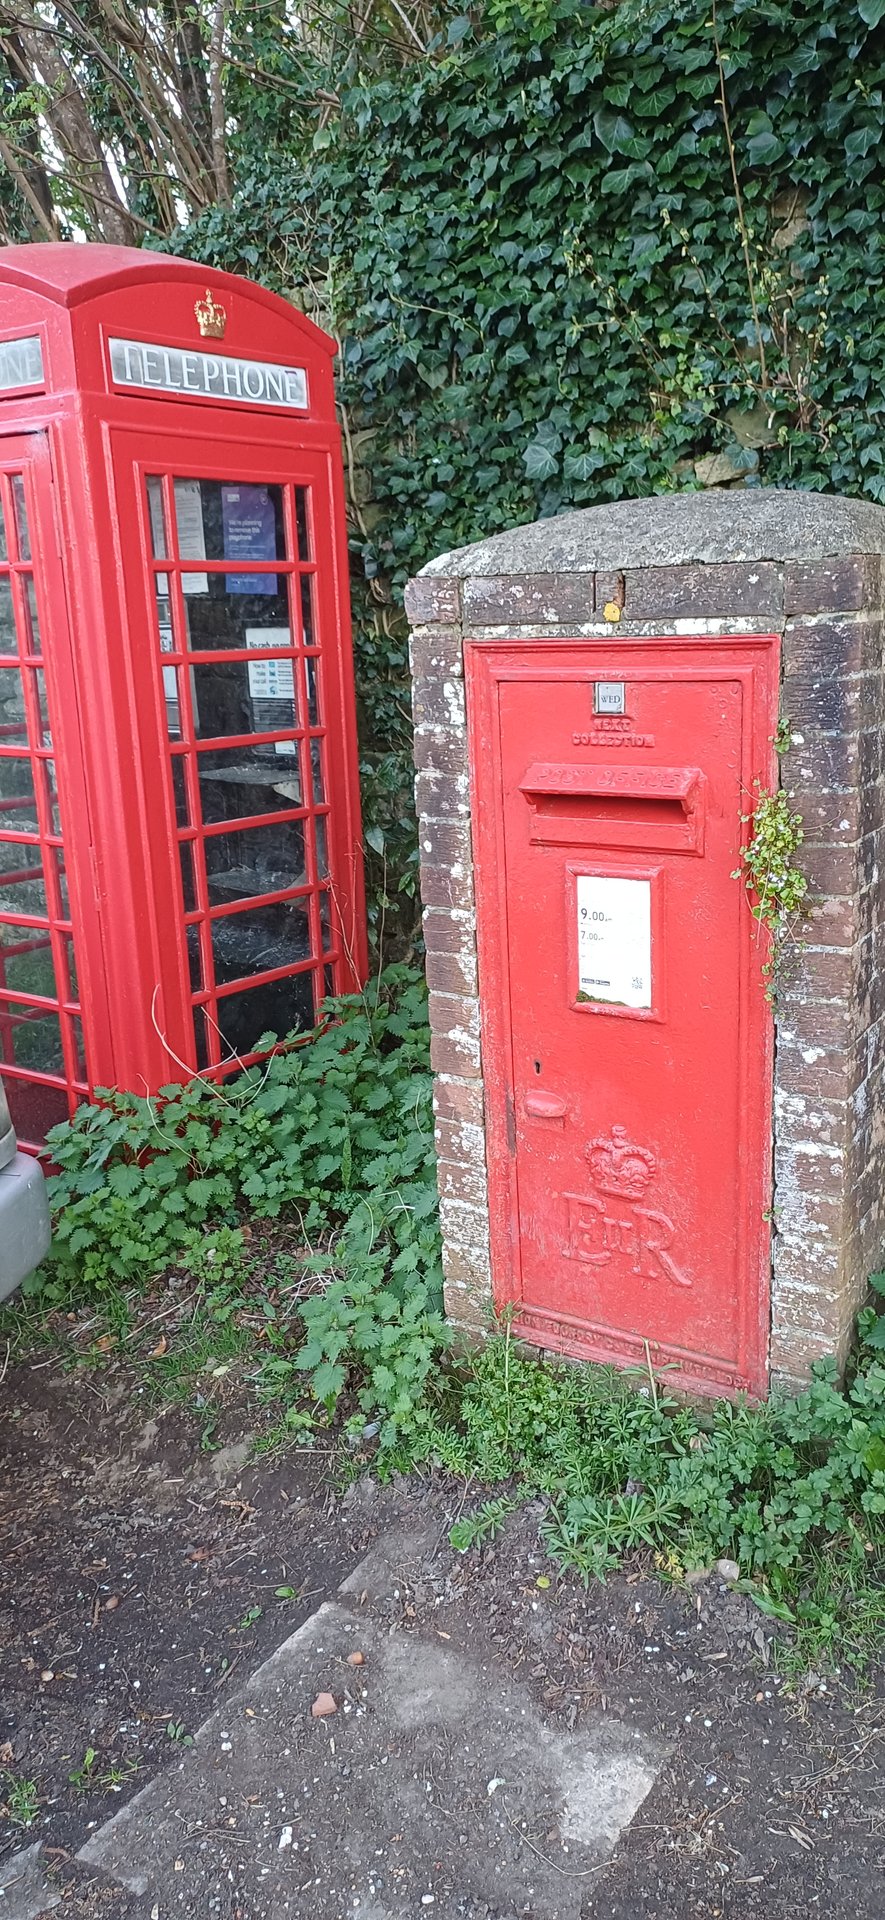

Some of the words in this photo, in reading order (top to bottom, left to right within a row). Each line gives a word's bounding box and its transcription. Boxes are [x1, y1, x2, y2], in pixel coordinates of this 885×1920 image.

[0, 343, 40, 387] NE
[123, 346, 298, 402] TELEPHONE
[601, 695, 621, 704] WED
[593, 718, 632, 733] NEXT
[572, 733, 655, 748] COLLECTION
